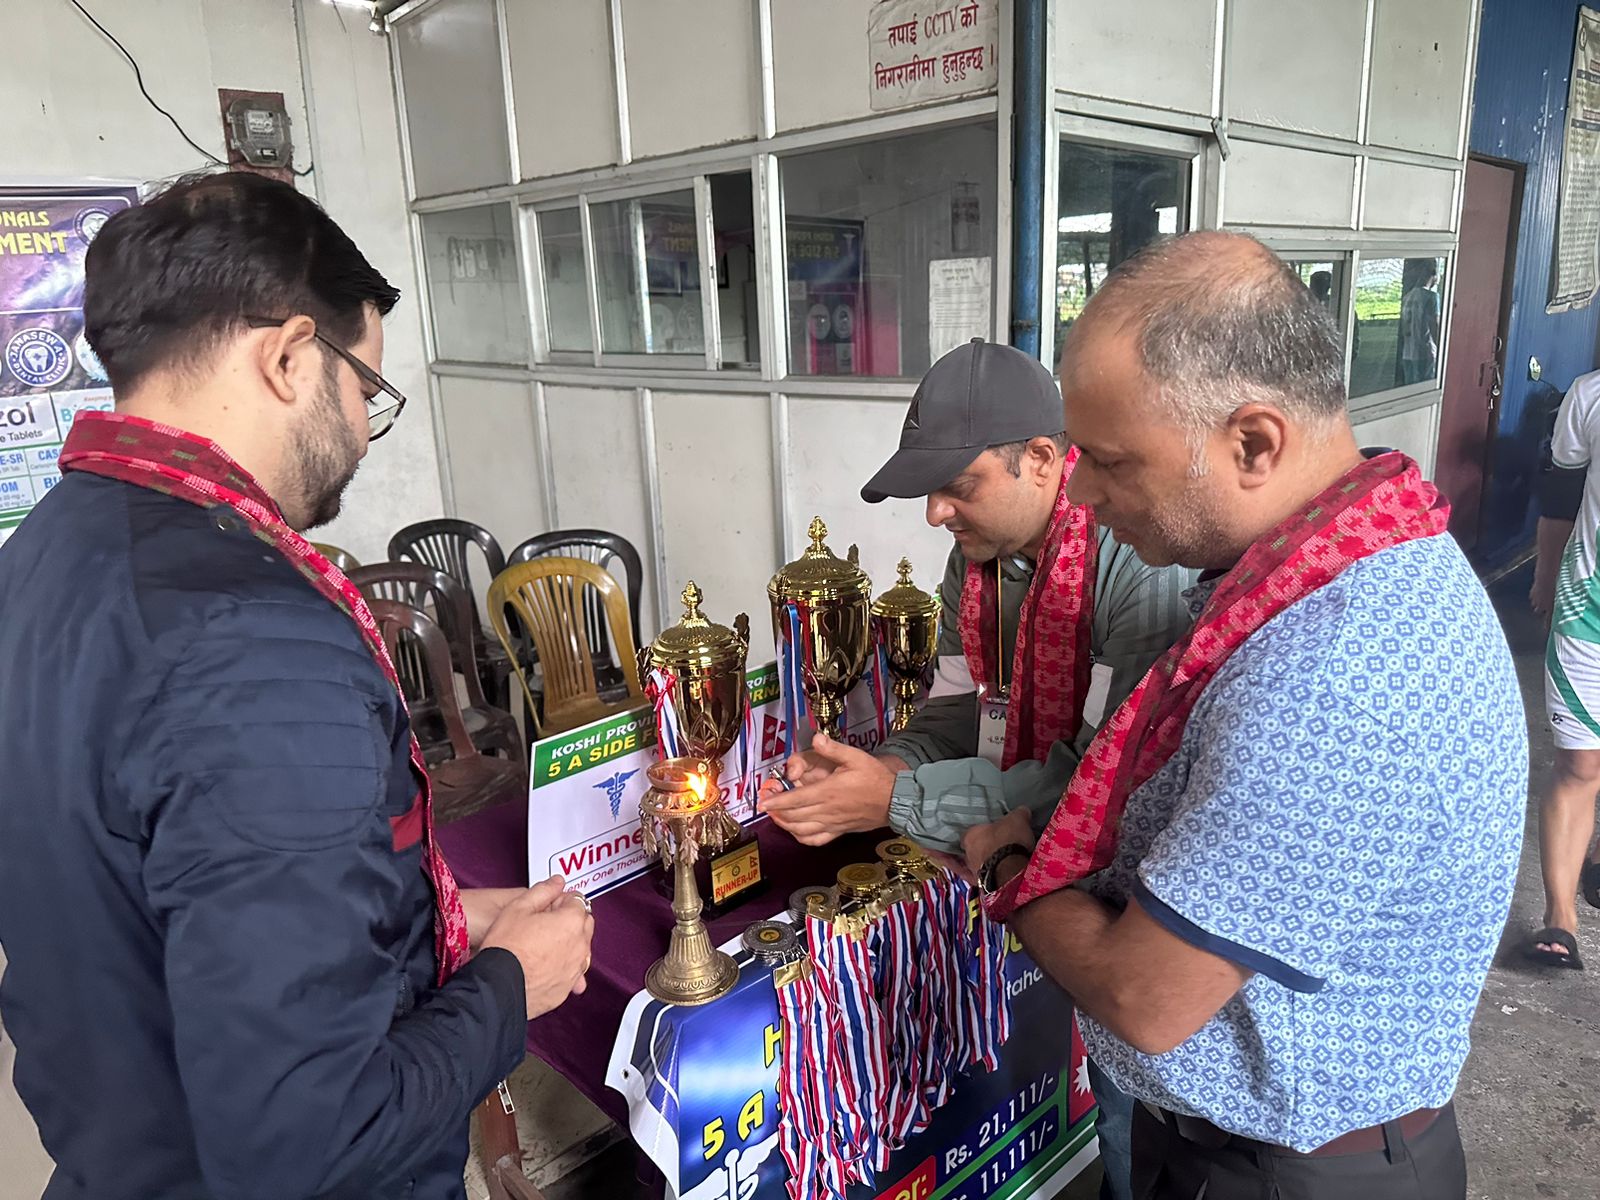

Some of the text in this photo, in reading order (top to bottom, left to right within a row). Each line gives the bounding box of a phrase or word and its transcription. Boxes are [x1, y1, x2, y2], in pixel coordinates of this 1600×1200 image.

[924, 5, 959, 39] CCTV
[960, 0, 979, 28] को
[875, 54, 937, 90] निगरानीमा
[0, 211, 50, 228] NALS
[0, 231, 67, 255] MENT
[10, 331, 63, 358] JANASEWA
[13, 356, 66, 383] DENTAL CLINIC
[7, 429, 43, 442] Tablets
[38, 449, 62, 461] CAS
[0, 481, 18, 493] OM
[548, 761, 561, 777] 5
[567, 754, 583, 771] A
[589, 734, 636, 762] SIDE
[551, 733, 601, 760] KOSHI
[592, 868, 614, 882] One
[715, 869, 758, 898] RUNNER-UP
[703, 1116, 725, 1161] 5
[737, 1090, 765, 1141] A
[945, 1143, 973, 1175] Rs.
[978, 1072, 1054, 1149] 21,111/-
[981, 1121, 1054, 1194] 11,111/-
